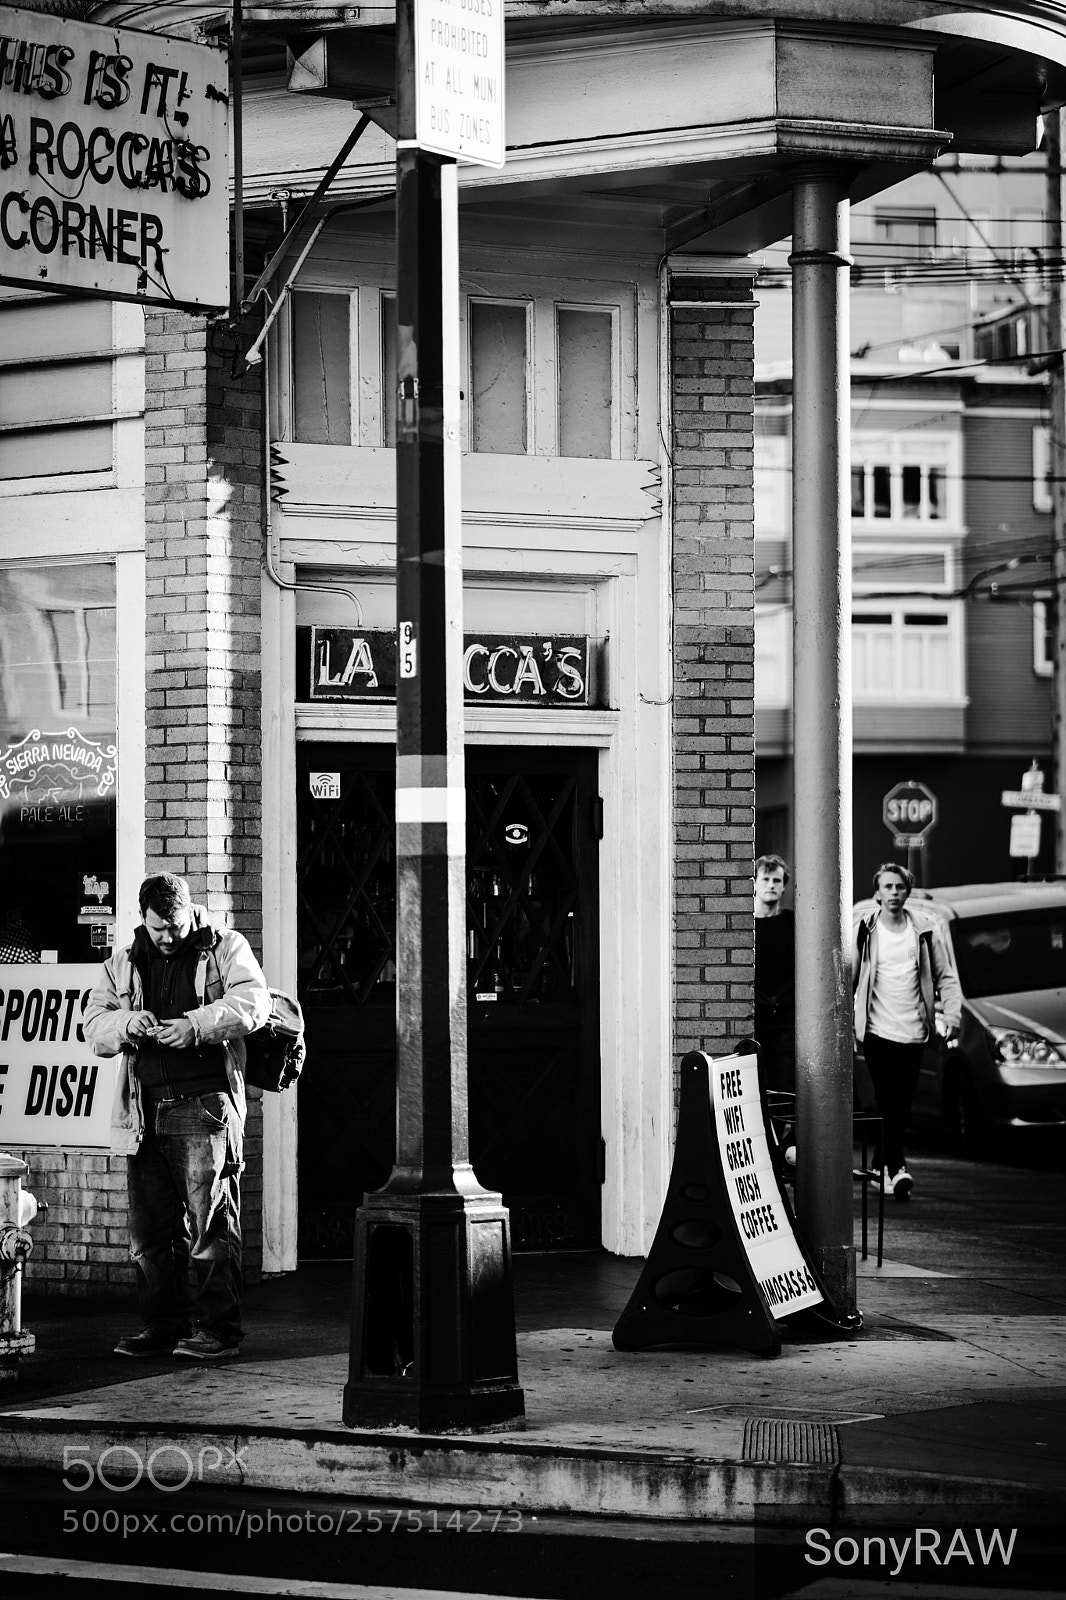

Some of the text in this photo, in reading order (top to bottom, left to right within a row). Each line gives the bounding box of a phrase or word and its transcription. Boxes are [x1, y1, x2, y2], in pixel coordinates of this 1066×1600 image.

[431, 18, 488, 58] PROHIBITED
[83, 50, 133, 110] IS
[424, 60, 497, 104] AT ALL MUNI
[431, 105, 491, 145] BUS ZONES
[1, 191, 163, 267] CORNER
[317, 638, 584, 698] LA CCA'S
[5, 744, 102, 775] SIERRA NEVADA
[20, 805, 84, 822] PALE ALE
[887, 799, 932, 822] STOP
[24, 1065, 99, 1117] DISH
[720, 1069, 743, 1100] FREE
[723, 1104, 746, 1136] WIFI
[726, 1137, 755, 1172] GREAT
[734, 1173, 762, 1205] IRISH
[740, 1204, 778, 1240] COFFEE
